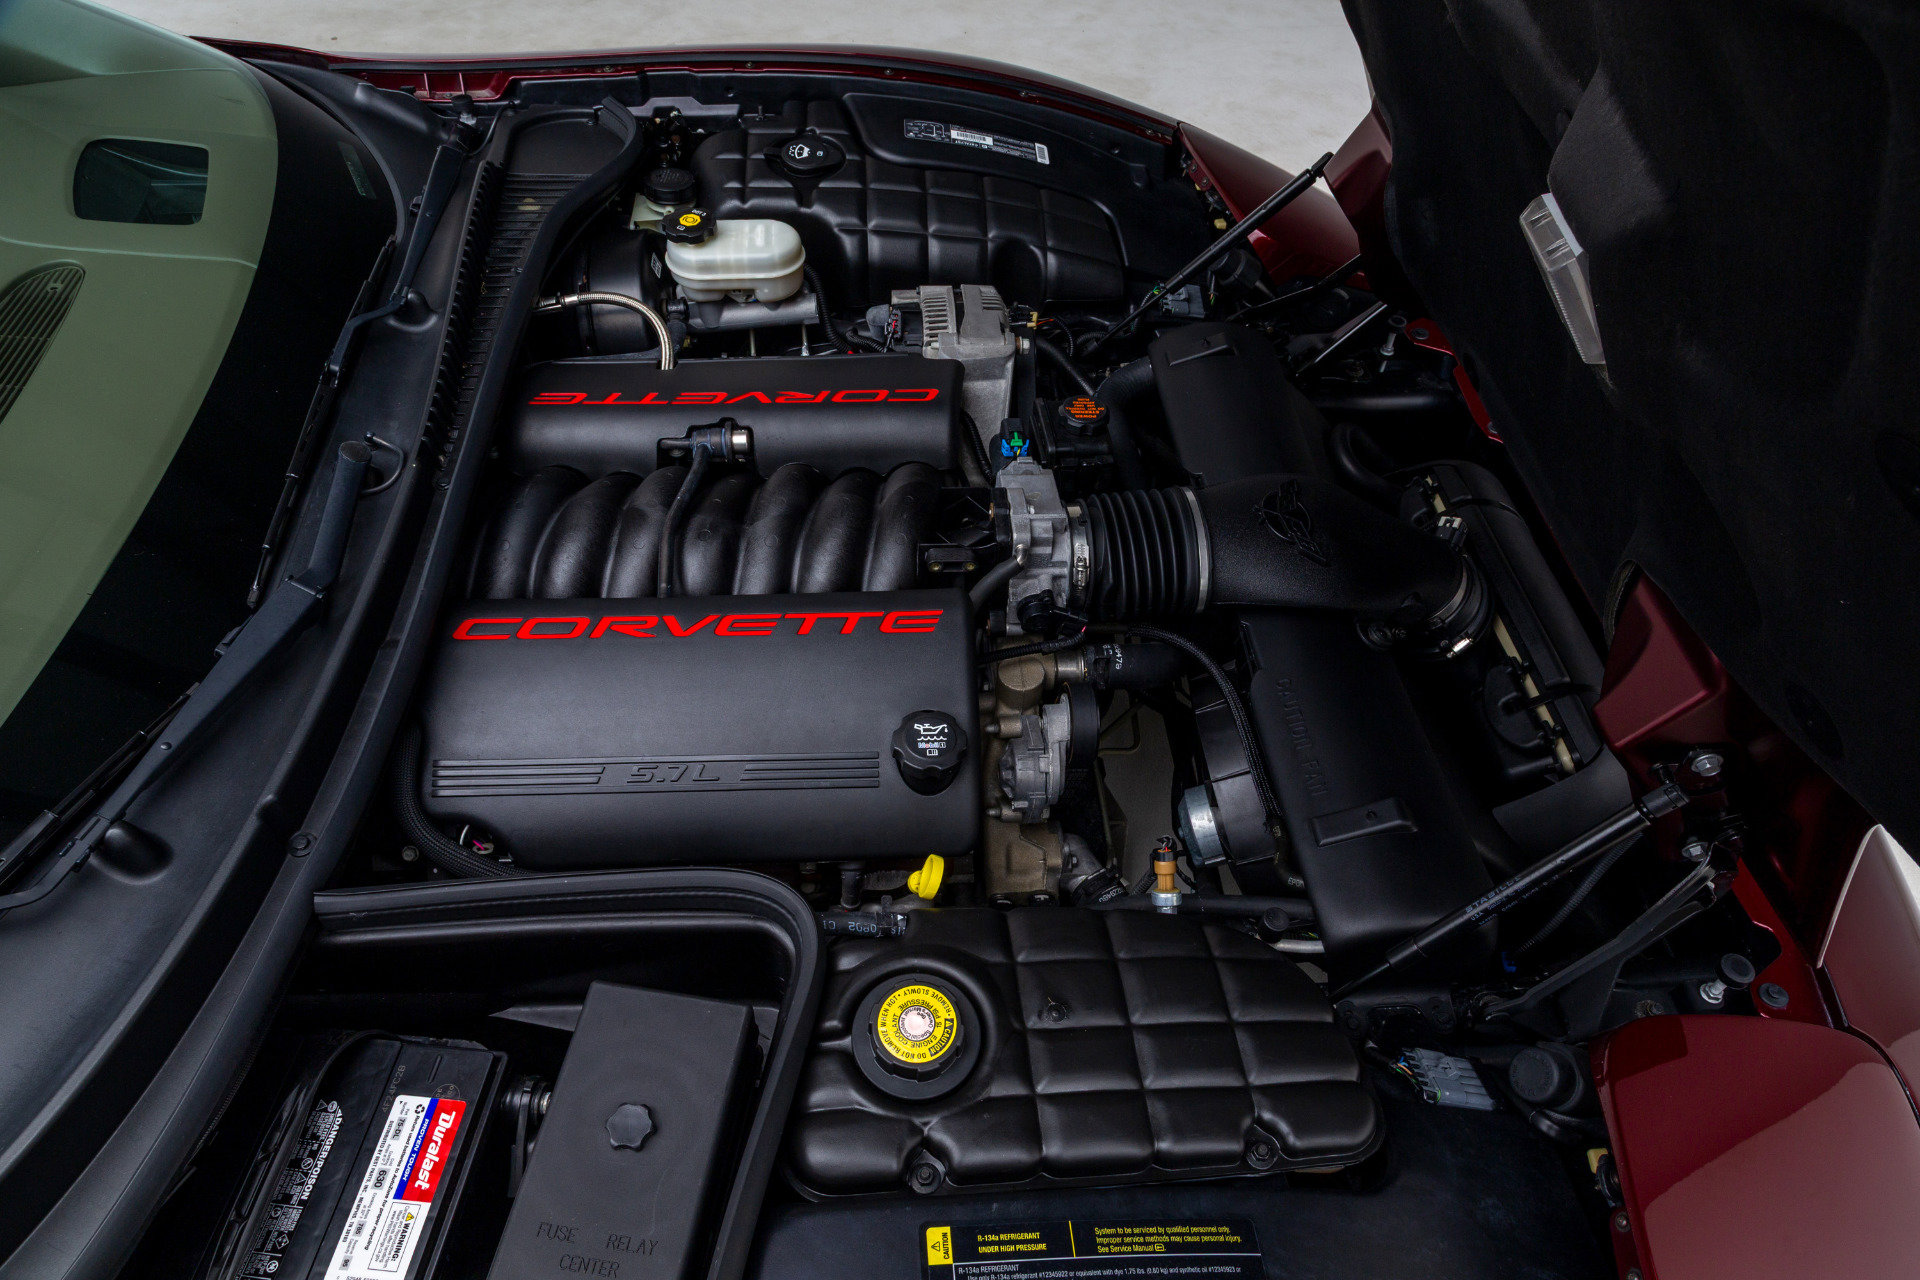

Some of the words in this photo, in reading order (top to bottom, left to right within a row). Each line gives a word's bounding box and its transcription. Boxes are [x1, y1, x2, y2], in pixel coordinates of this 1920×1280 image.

[529, 388, 940, 405] CORVETTE
[452, 609, 944, 640] CORVETTE
[626, 764, 720, 783] 5.7L
[887, 995, 897, 1008] HOT
[903, 988, 930, 996] SLOWLY
[898, 998, 933, 1011] PRESSURE
[930, 992, 952, 1014] REMOVE
[880, 1008, 890, 1028] WHEN
[932, 1008, 941, 1020] PSI
[892, 1013, 908, 1046] COOLANT
[880, 1030, 901, 1054] REMOVE
[911, 1034, 938, 1048] ENGINE
[930, 1028, 951, 1054] CAUTION
[900, 1050, 915, 1059] NOT
[392, 1118, 405, 1138] 75-DL
[413, 1118, 429, 1150] PROVEN
[413, 1109, 456, 1188] Duralast
[301, 1117, 343, 1200] DANGER/POISON
[402, 1153, 416, 1180] TOUGH
[372, 1169, 387, 1187] 630
[354, 1223, 364, 1234] 785
[978, 1234, 998, 1242] R-134a
[1000, 1232, 1040, 1240] REFRIGERANT
[1095, 1227, 1116, 1236] System
[1158, 1226, 1165, 1234] by
[1166, 1226, 1189, 1234] qualified
[1191, 1226, 1217, 1234] personnel
[1218, 1226, 1231, 1234] only.
[390, 1222, 410, 1261] WARNING:
[536, 1222, 579, 1244] FUSE
[606, 1234, 658, 1256] RELAY
[942, 1232, 950, 1260] CAUTION
[978, 1245, 999, 1253] UNDER
[1016, 1243, 1047, 1251] PRESSURE
[1096, 1236, 1122, 1245] Improper
[1201, 1235, 1224, 1243] personal
[1225, 1235, 1242, 1243] injury.
[1098, 1245, 1109, 1253] See
[560, 1254, 620, 1278] CENTER
[958, 1266, 980, 1274] R-134a
[981, 1264, 1019, 1273] REFRIGERANT
